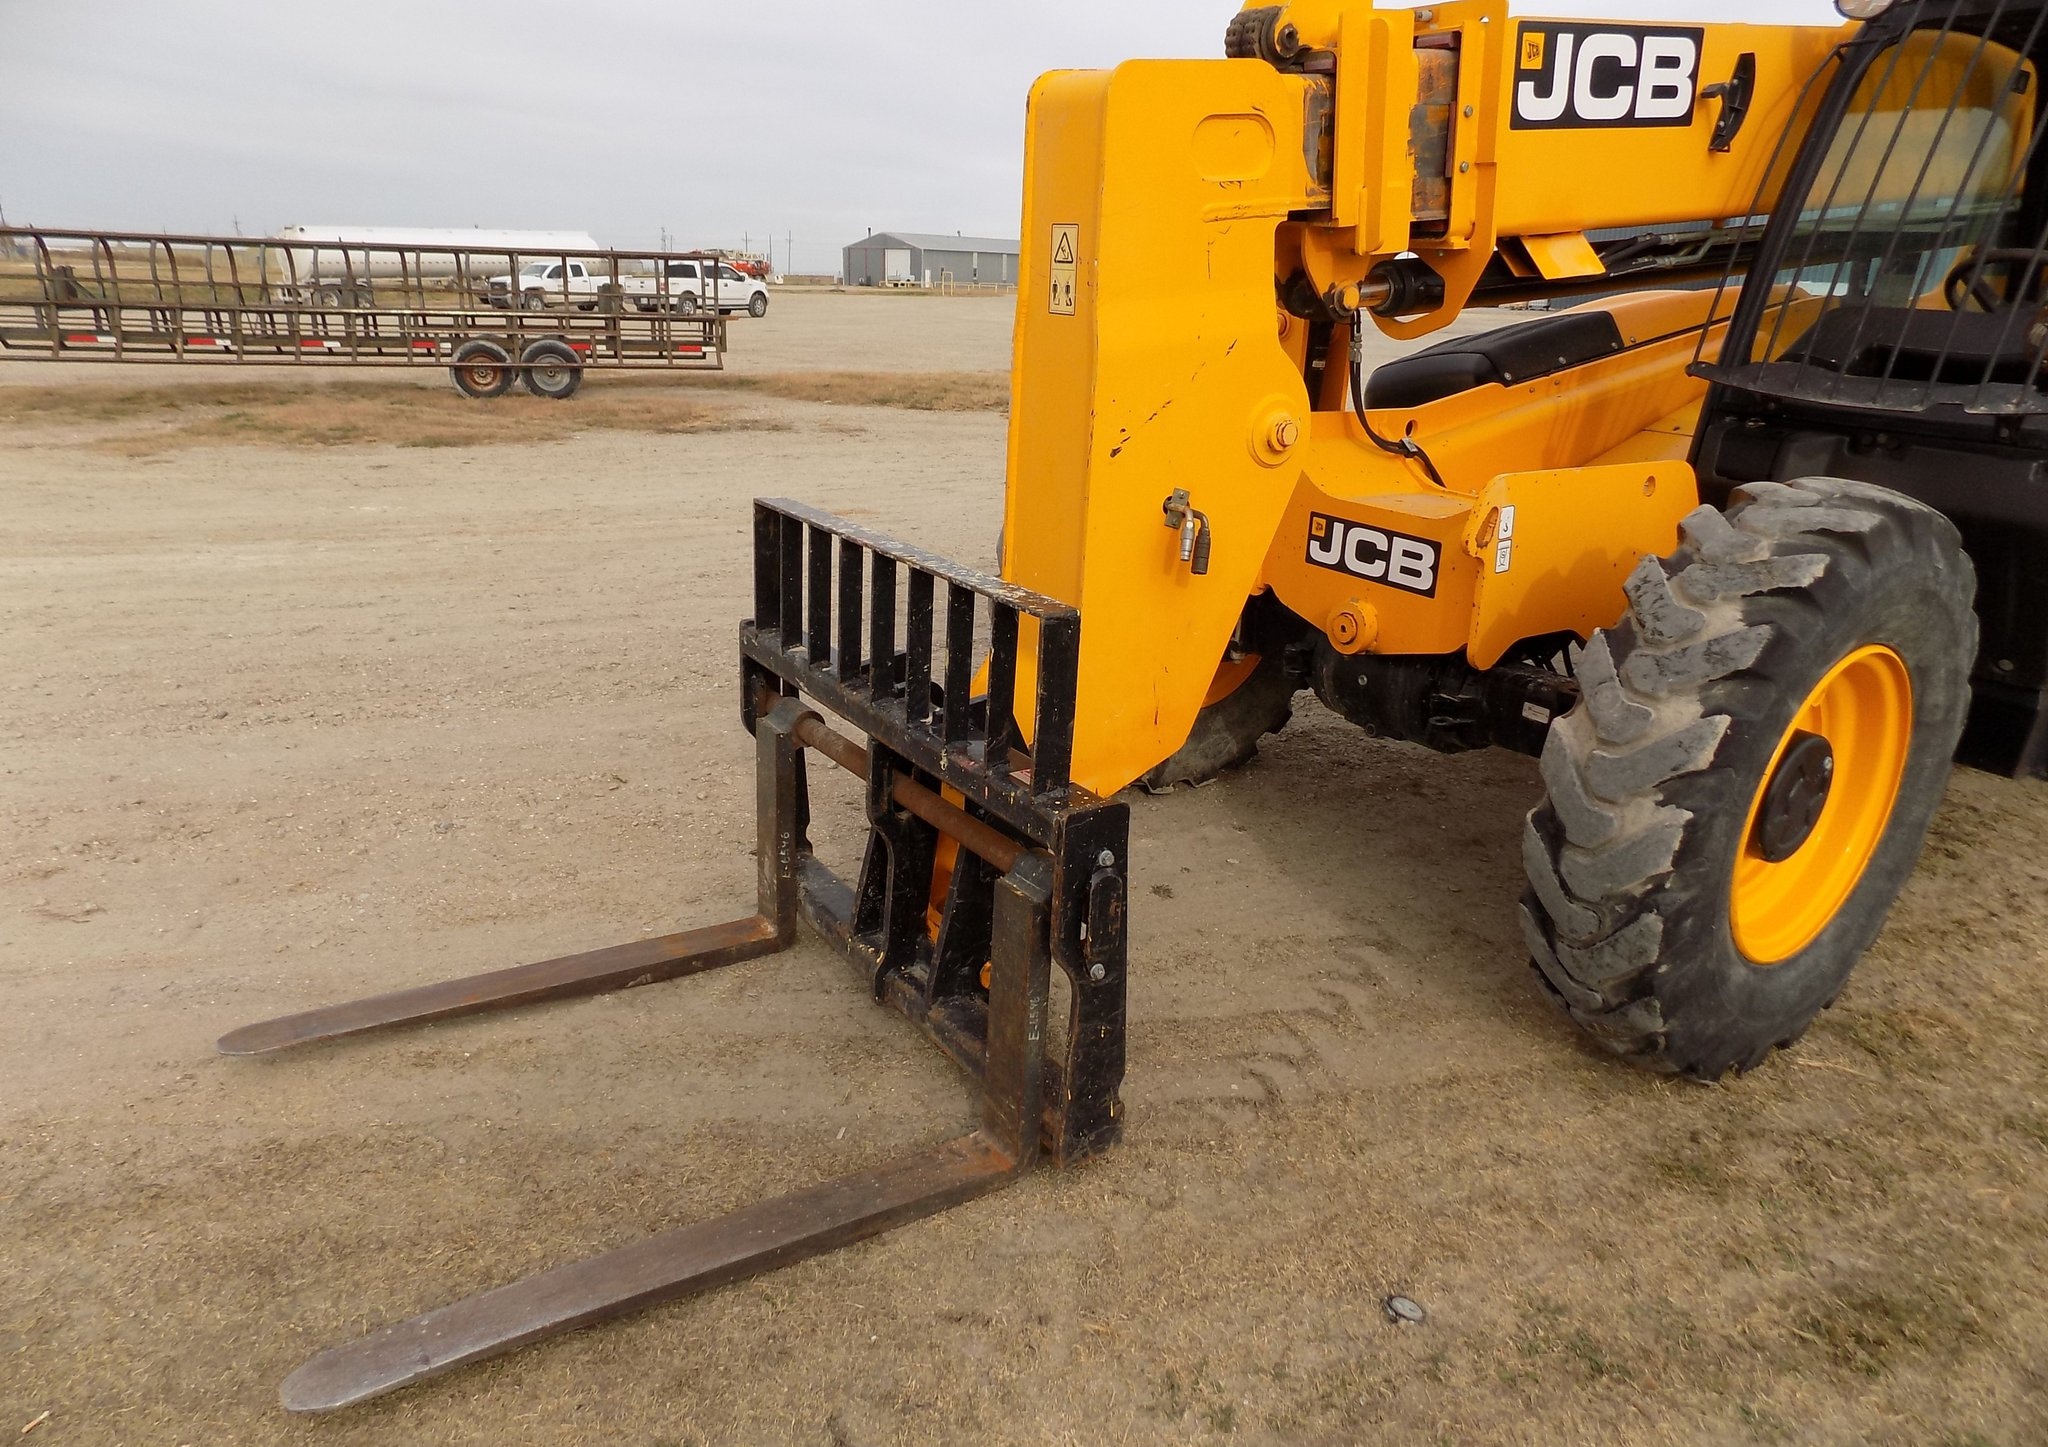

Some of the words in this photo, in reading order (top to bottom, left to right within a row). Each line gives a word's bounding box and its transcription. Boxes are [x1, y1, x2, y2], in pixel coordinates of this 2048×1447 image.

[1517, 33, 1696, 121] JCB
[1527, 42, 1540, 60] JCB
[1309, 521, 1435, 591] JCB
